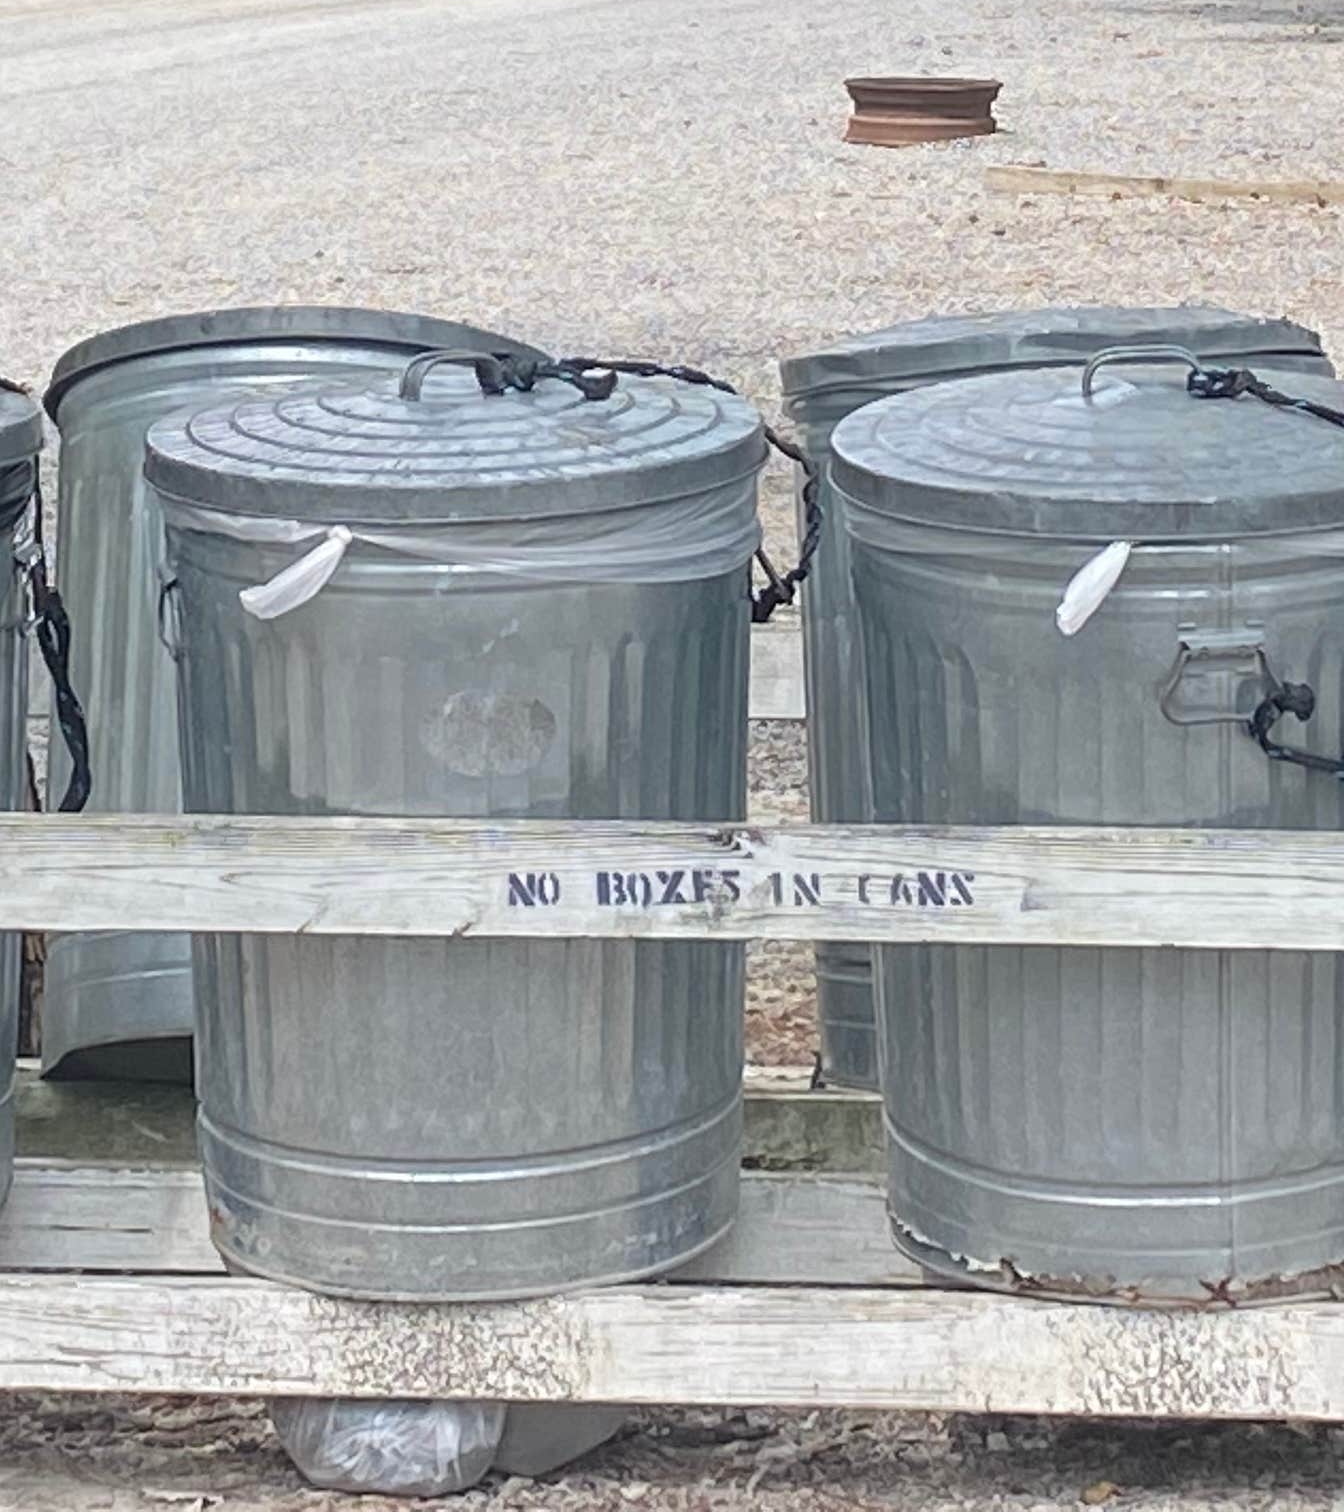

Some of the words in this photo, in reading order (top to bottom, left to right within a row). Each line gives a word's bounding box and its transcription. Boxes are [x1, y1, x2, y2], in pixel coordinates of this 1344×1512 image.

[508, 871, 560, 907] NO
[597, 869, 741, 907] BOXES
[768, 871, 821, 907] IN
[858, 871, 977, 908] CANS
